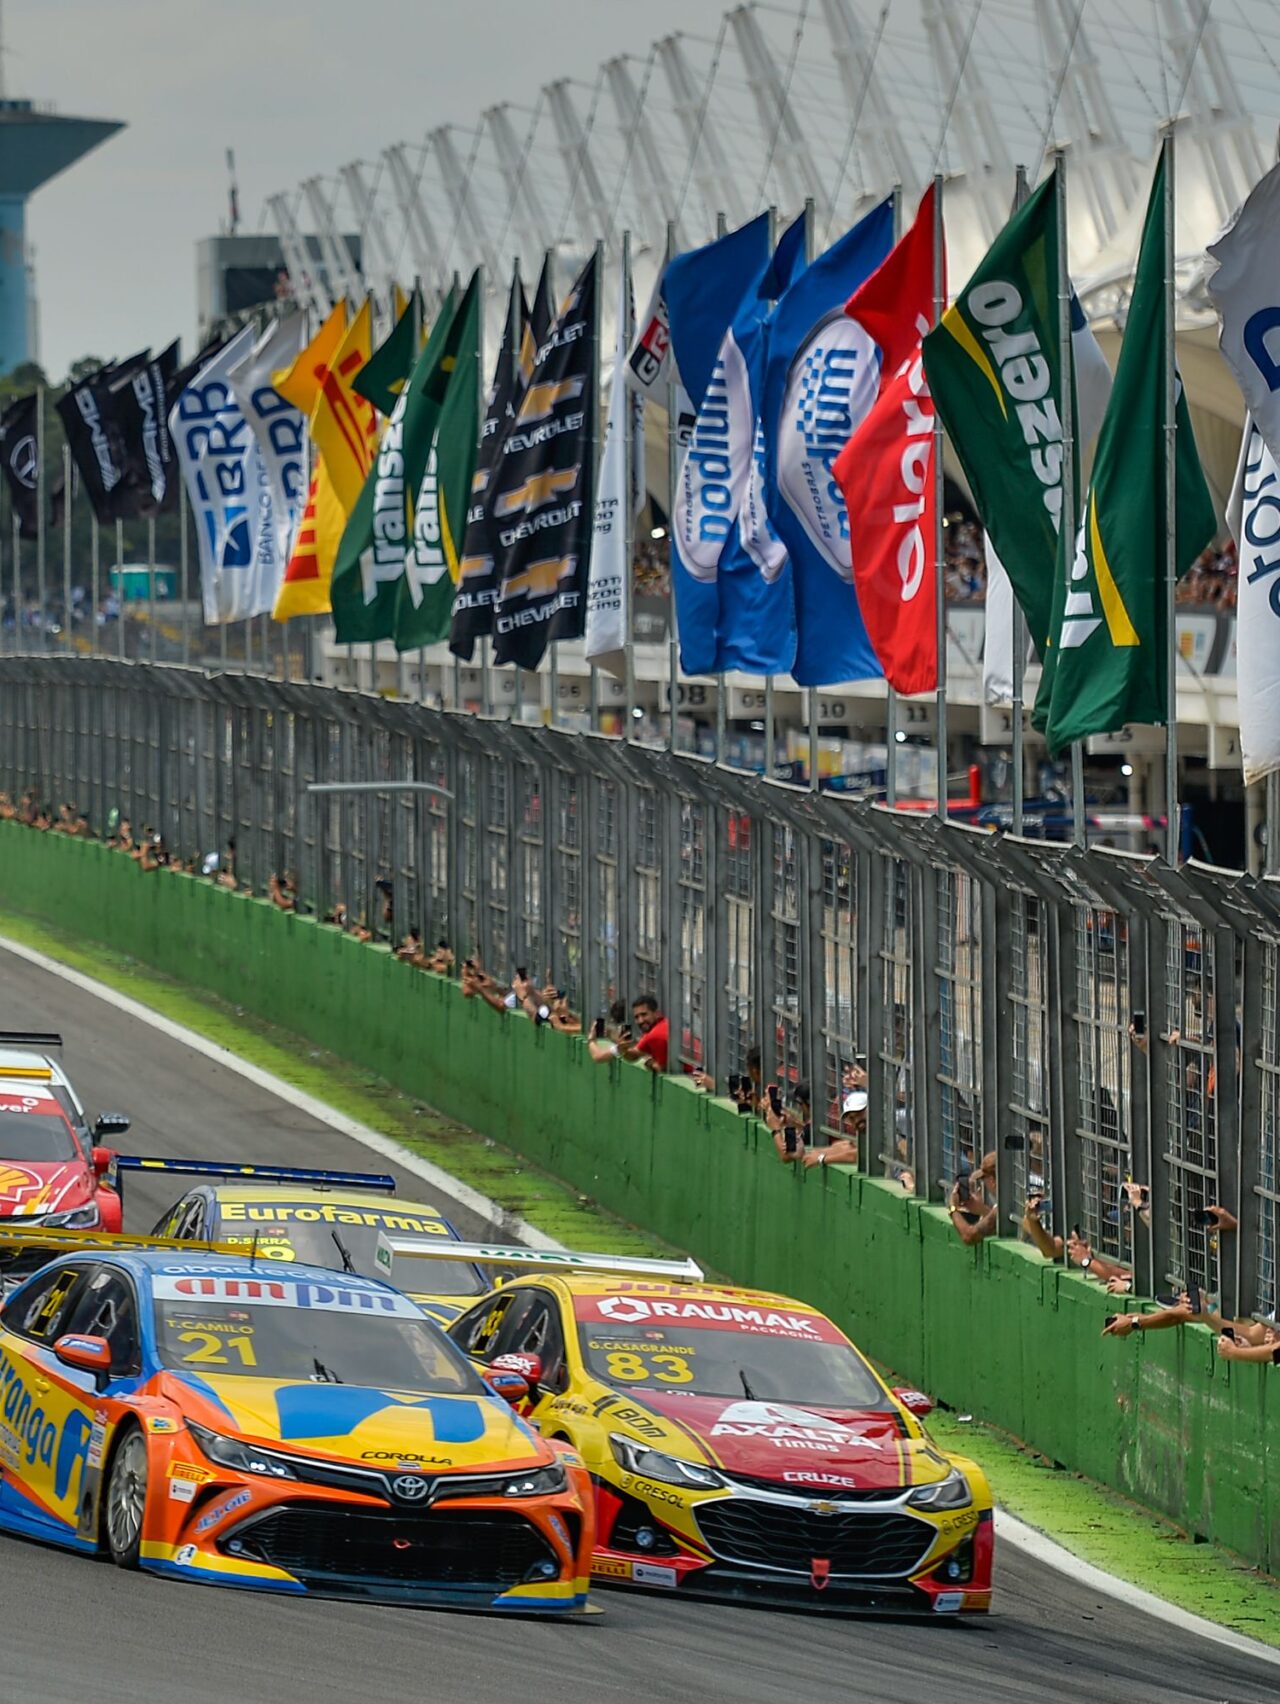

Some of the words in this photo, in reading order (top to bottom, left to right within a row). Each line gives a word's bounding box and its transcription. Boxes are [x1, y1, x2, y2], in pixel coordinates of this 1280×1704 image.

[801, 462, 832, 539] PETROBRAS
[668, 685, 705, 704] 08
[819, 703, 846, 718] 10
[906, 706, 929, 722] 11
[220, 1202, 449, 1236] Eurofarma
[166, 1318, 254, 1334] T.CAMILO
[650, 1302, 819, 1334] RAUMAK
[740, 1323, 823, 1342] PACKAGING
[177, 1331, 257, 1366] 21
[588, 1340, 697, 1356] G.CASAGRANDE
[605, 1352, 694, 1384] 83
[710, 1423, 884, 1451] AXALTA
[769, 1437, 840, 1453] Tintas
[361, 1450, 452, 1466] COROLLA
[783, 1471, 856, 1488] CRUZE
[634, 1480, 684, 1509] CRESOL
